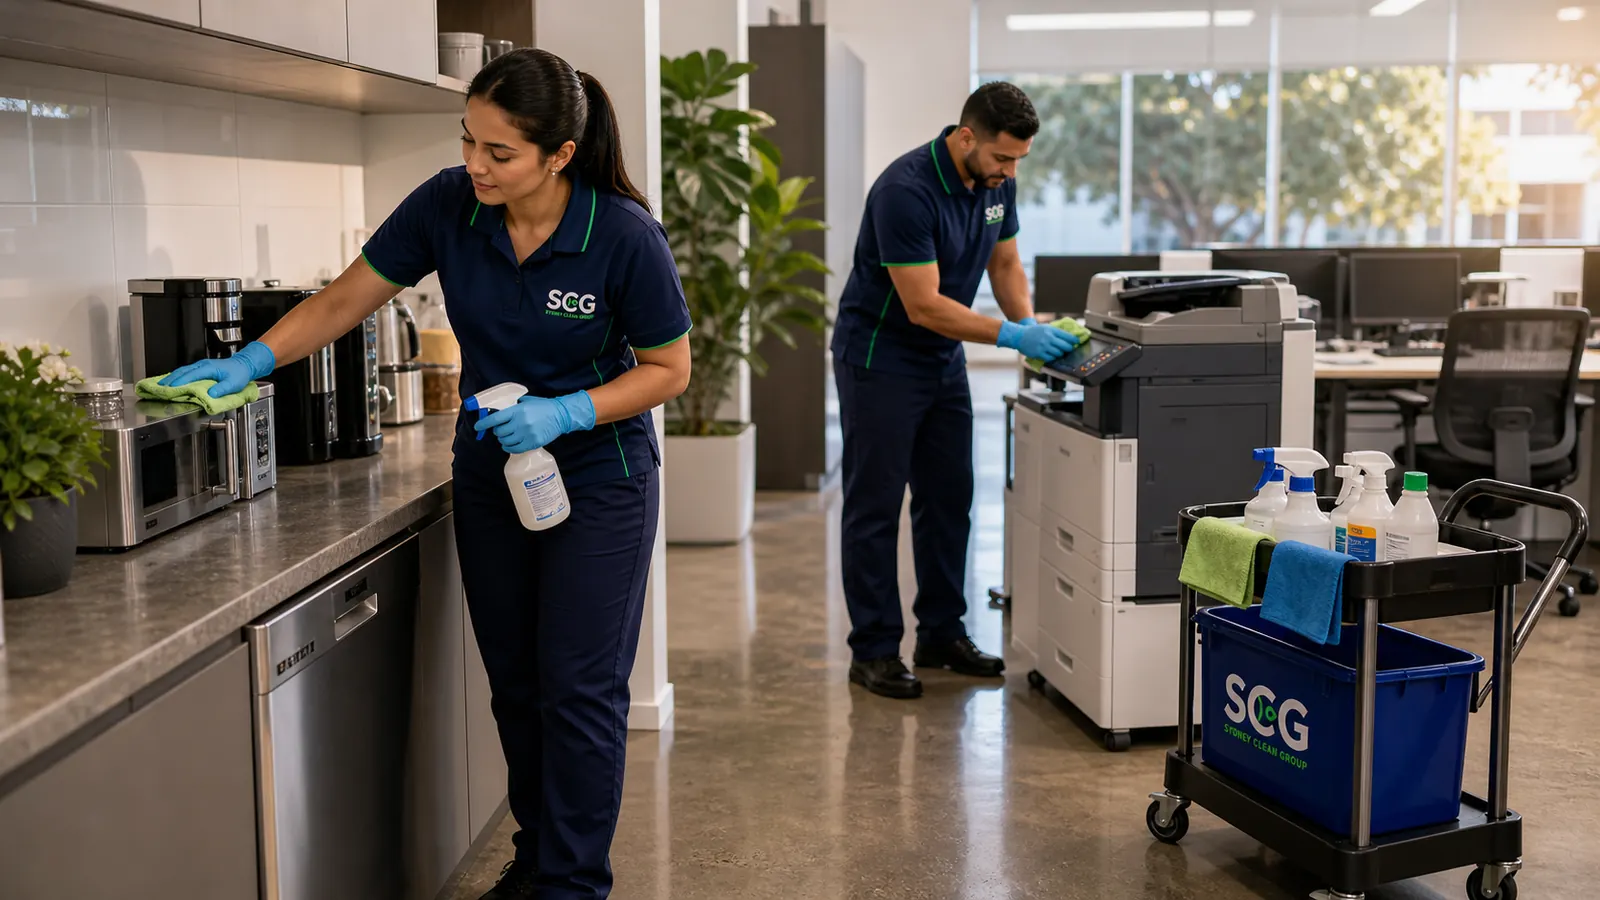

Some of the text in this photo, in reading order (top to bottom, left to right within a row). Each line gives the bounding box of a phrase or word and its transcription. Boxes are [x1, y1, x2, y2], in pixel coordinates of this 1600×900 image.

[546, 289, 596, 314] SCG
[1224, 673, 1309, 752] SCG
[1253, 738, 1278, 757] CLEAN
[1279, 750, 1308, 770] GROUP
